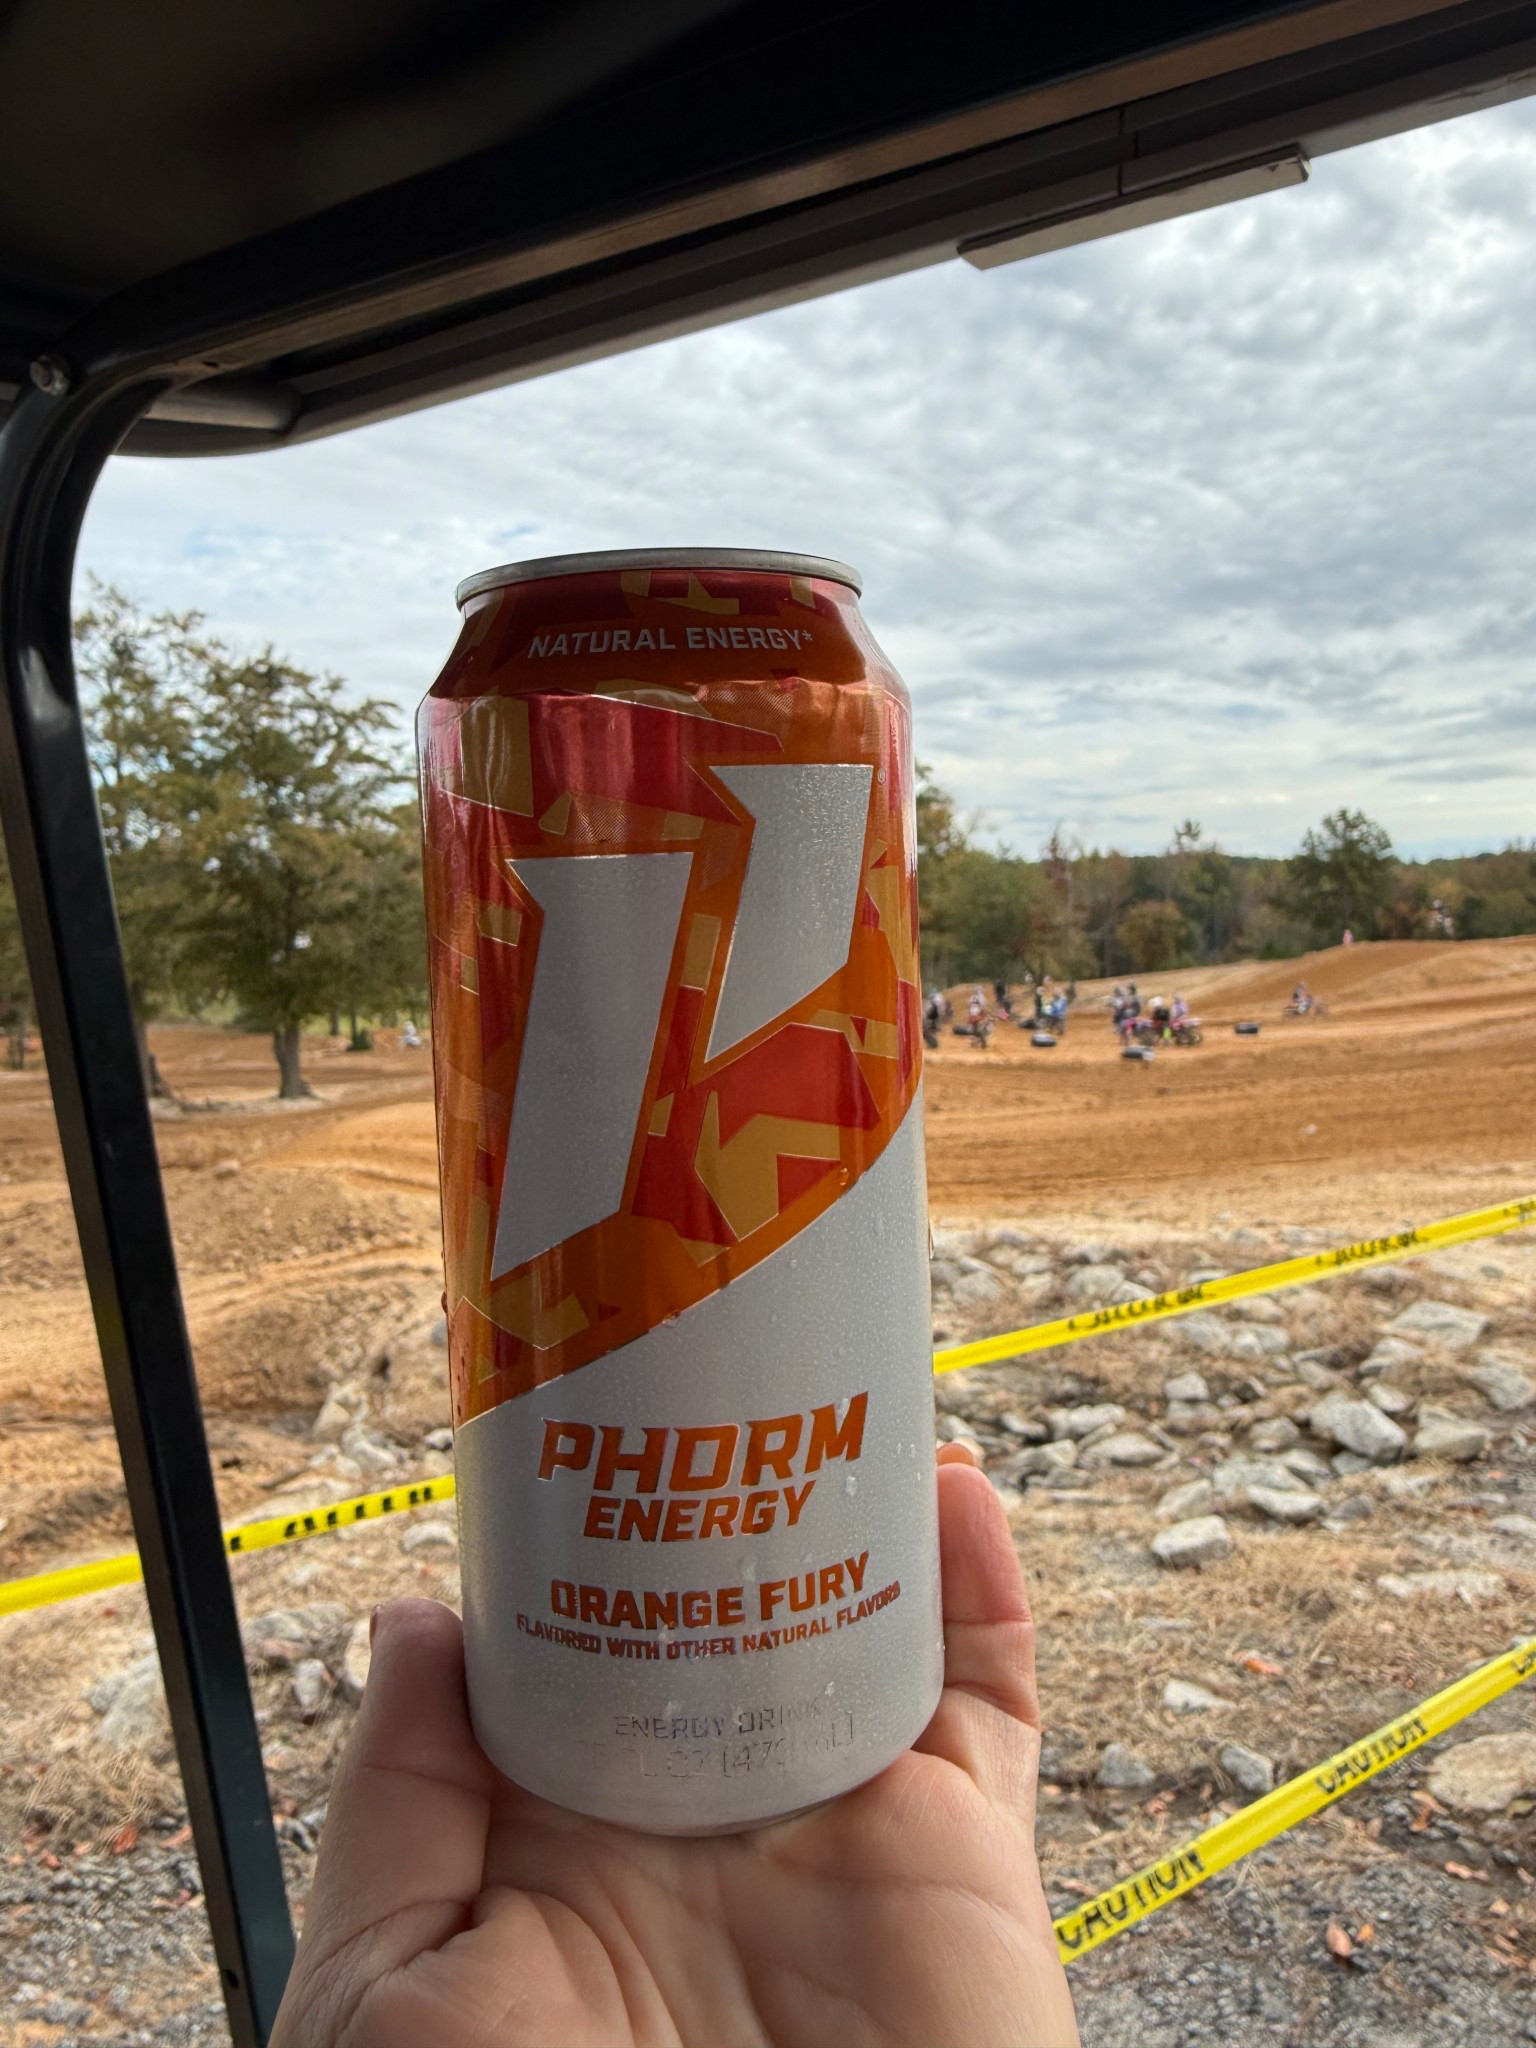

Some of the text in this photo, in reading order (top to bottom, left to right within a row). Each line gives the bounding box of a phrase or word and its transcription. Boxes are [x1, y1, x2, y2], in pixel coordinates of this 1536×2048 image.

[528, 628, 676, 659] NATURAL
[537, 1391, 869, 1494] PHORM
[583, 1480, 817, 1543] ENERGY
[550, 1550, 870, 1630] ORANGE FURY
[516, 1612, 602, 1654] FLAVORED
[606, 1637, 661, 1660] WITH
[666, 1636, 737, 1661] OTHER
[742, 1620, 832, 1652] NATURAL
[614, 1715, 726, 1740] ENERGY
